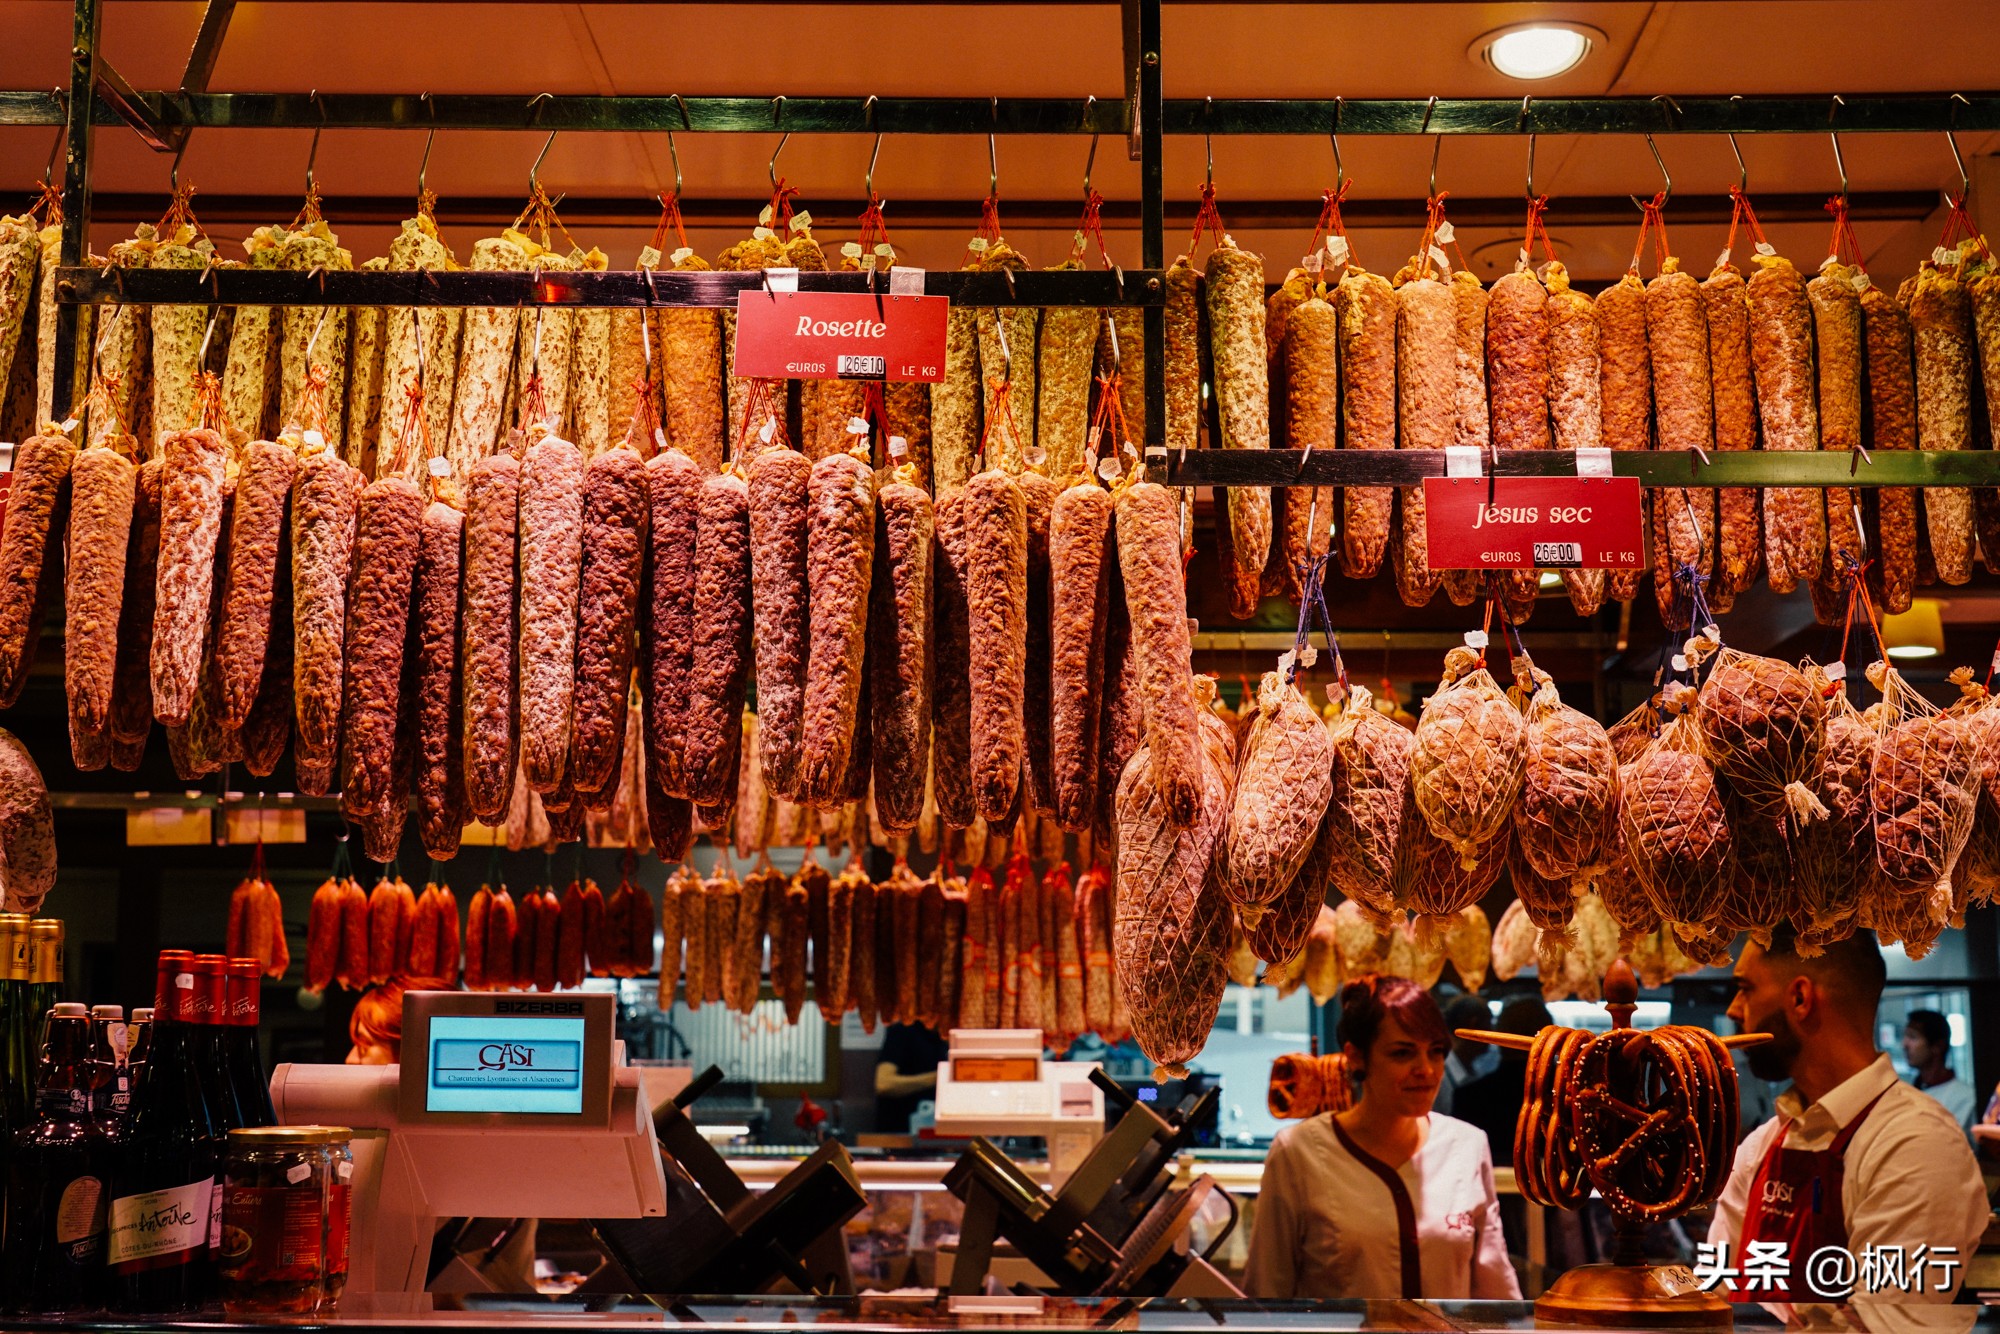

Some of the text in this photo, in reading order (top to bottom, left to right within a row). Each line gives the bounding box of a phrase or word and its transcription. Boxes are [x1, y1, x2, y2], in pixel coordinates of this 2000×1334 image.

[795, 315, 887, 338] Rosette
[845, 356, 885, 375] 26€10
[902, 365, 915, 376] LE
[922, 366, 937, 377] KG
[1472, 502, 1592, 529] Jésus sec
[1534, 543, 1574, 562] 26€00
[1599, 551, 1613, 562] LE
[1620, 551, 1635, 563] KG
[495, 1001, 583, 1014] BIZERBA
[478, 1043, 535, 1071] GAST
[448, 1074, 486, 1082] Charcuteries
[487, 1075, 520, 1083] Lyonnaises
